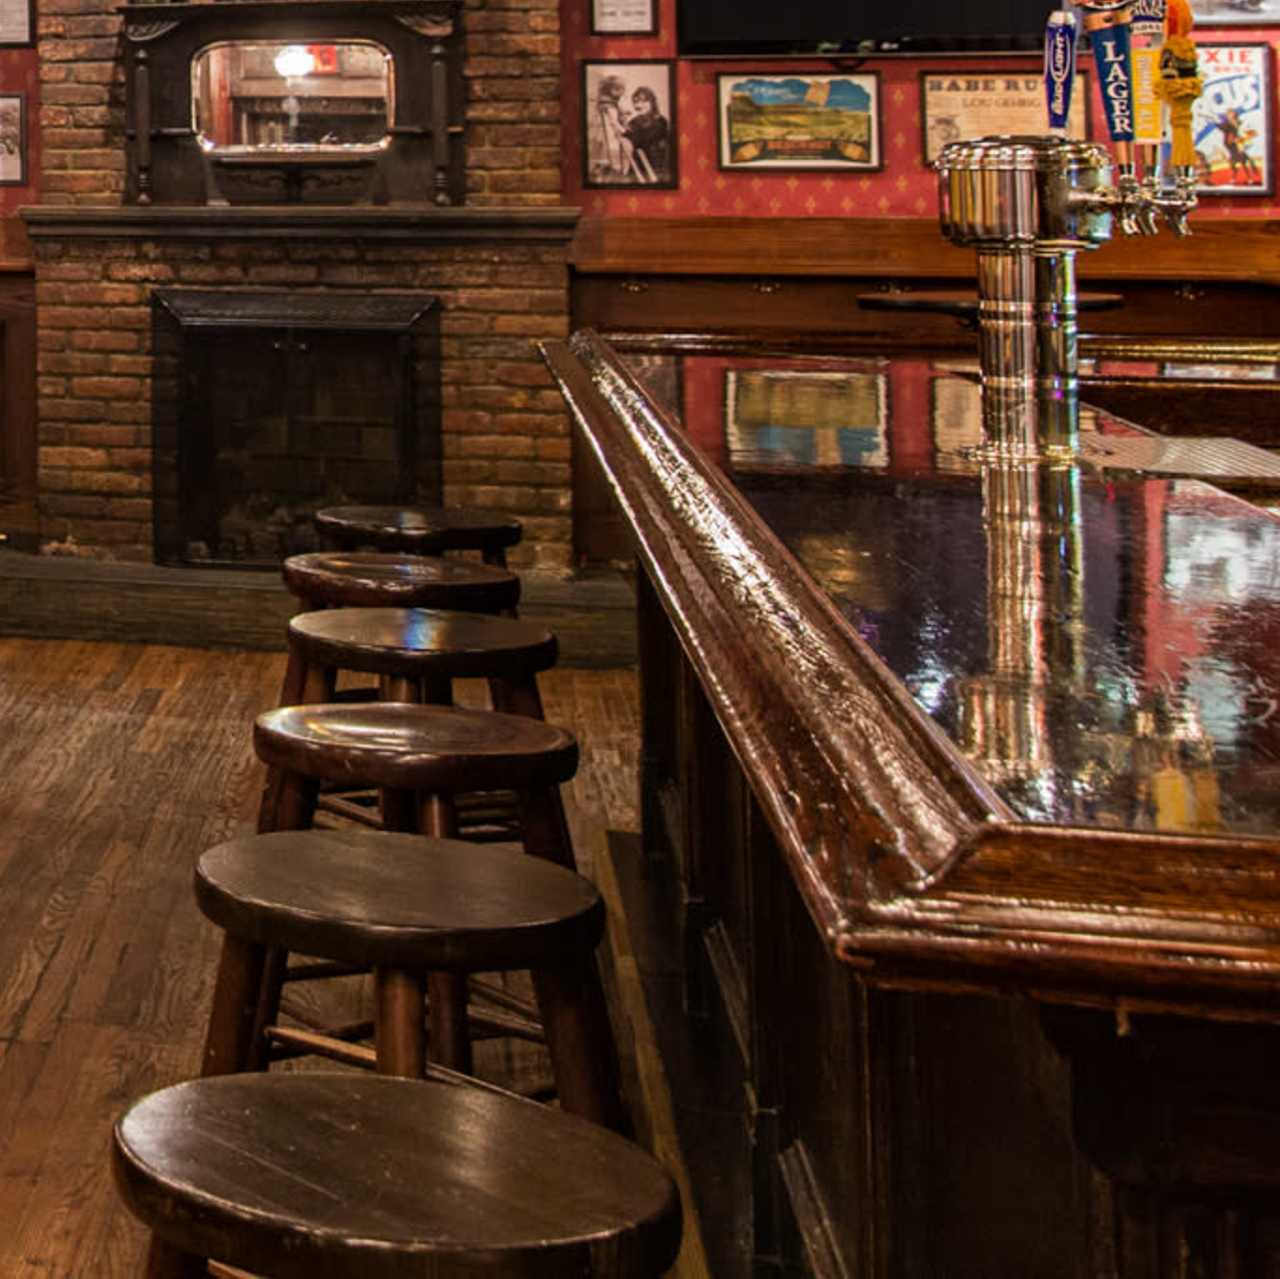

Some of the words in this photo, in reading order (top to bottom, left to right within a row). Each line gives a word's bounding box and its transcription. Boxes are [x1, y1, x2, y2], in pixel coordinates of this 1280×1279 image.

[929, 80, 996, 92] BABE
[1005, 80, 1038, 92] RU
[1102, 41, 1133, 133] LAGER
